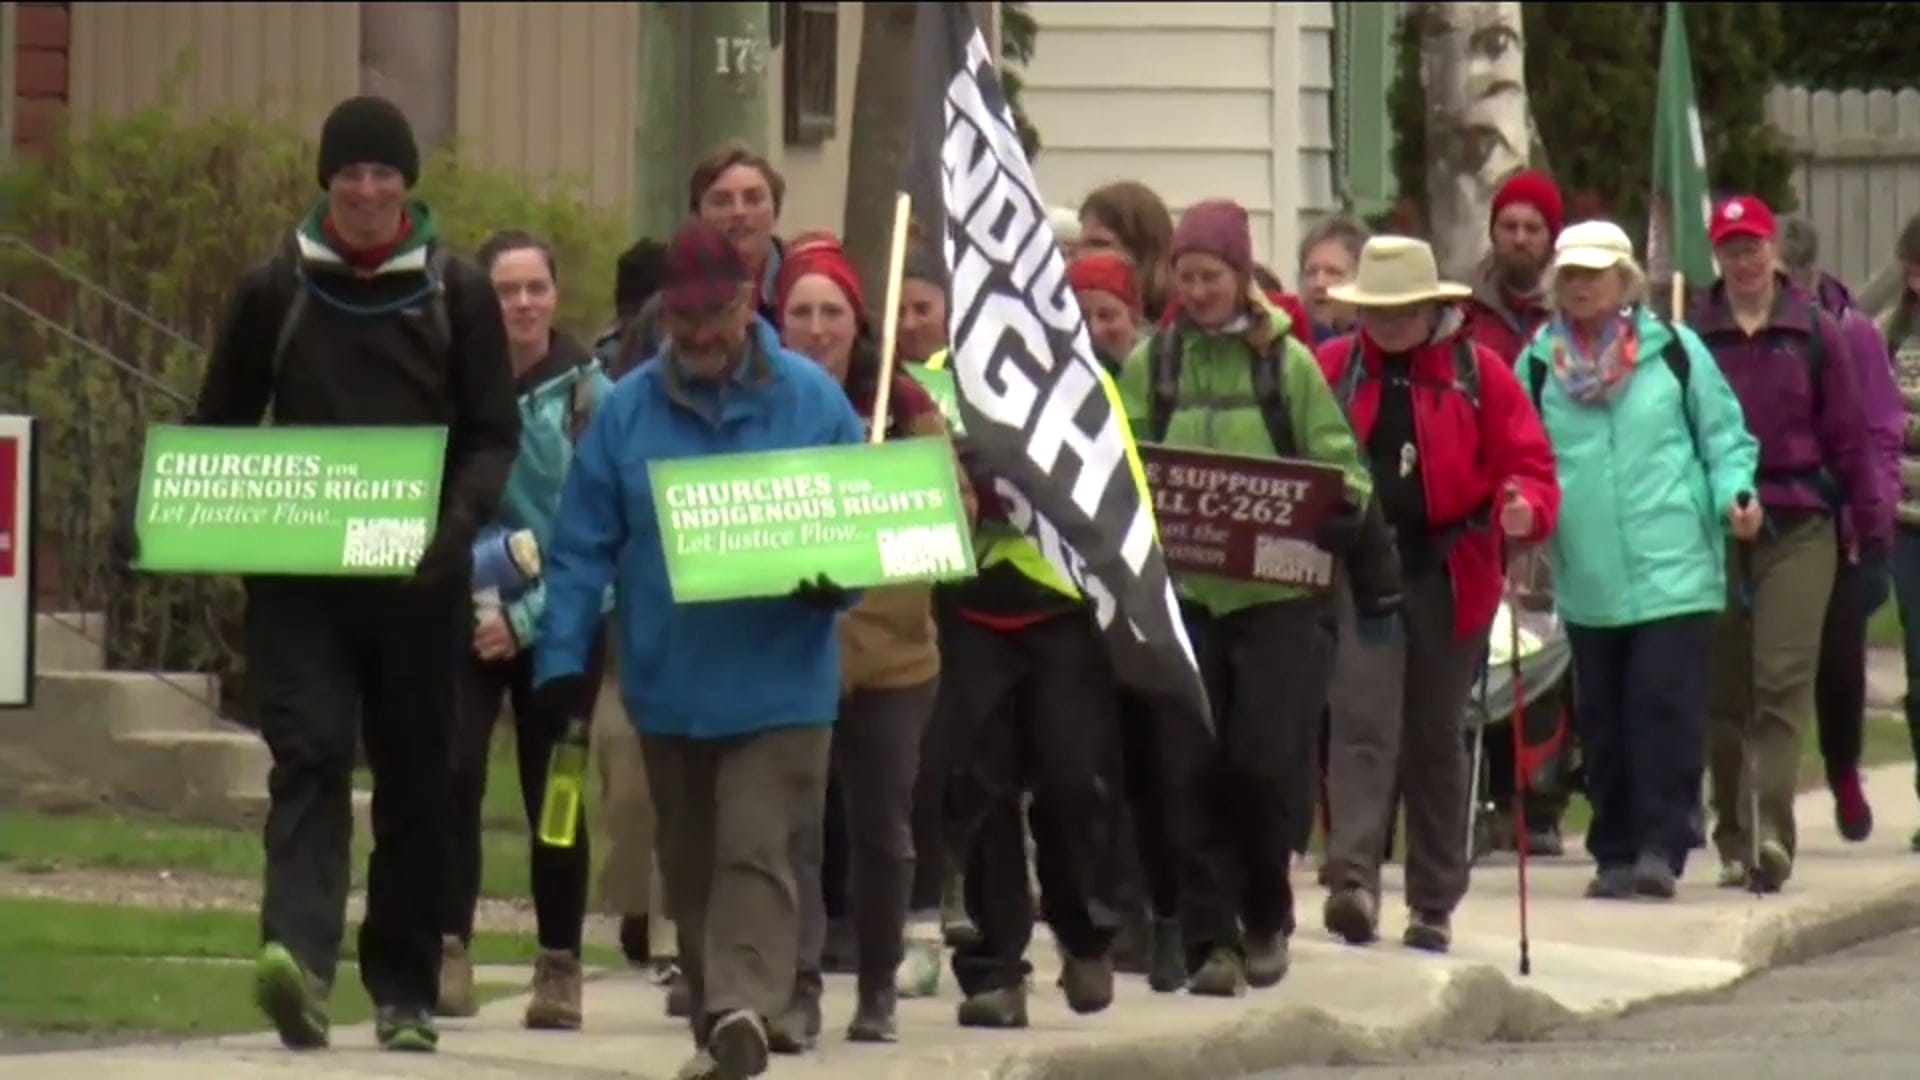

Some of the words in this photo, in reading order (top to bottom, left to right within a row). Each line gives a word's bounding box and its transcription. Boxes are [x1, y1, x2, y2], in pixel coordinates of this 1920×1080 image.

[156, 453, 321, 477] CHURCHES
[327, 463, 358, 476] FOR
[153, 478, 317, 499] INDIGENOUS
[325, 479, 423, 500] RIGHTS
[666, 474, 831, 507] CHURCHES
[838, 479, 872, 494] FOR
[1147, 463, 1161, 482] E
[1168, 466, 1312, 501] SUPPORT
[149, 502, 184, 524] Let
[188, 502, 268, 528] Justice
[671, 497, 837, 529] INDIGENOUS
[844, 488, 943, 517] RIGHTS
[1198, 492, 1294, 526] C-262
[677, 532, 712, 555] Let
[720, 528, 794, 555] Justice
